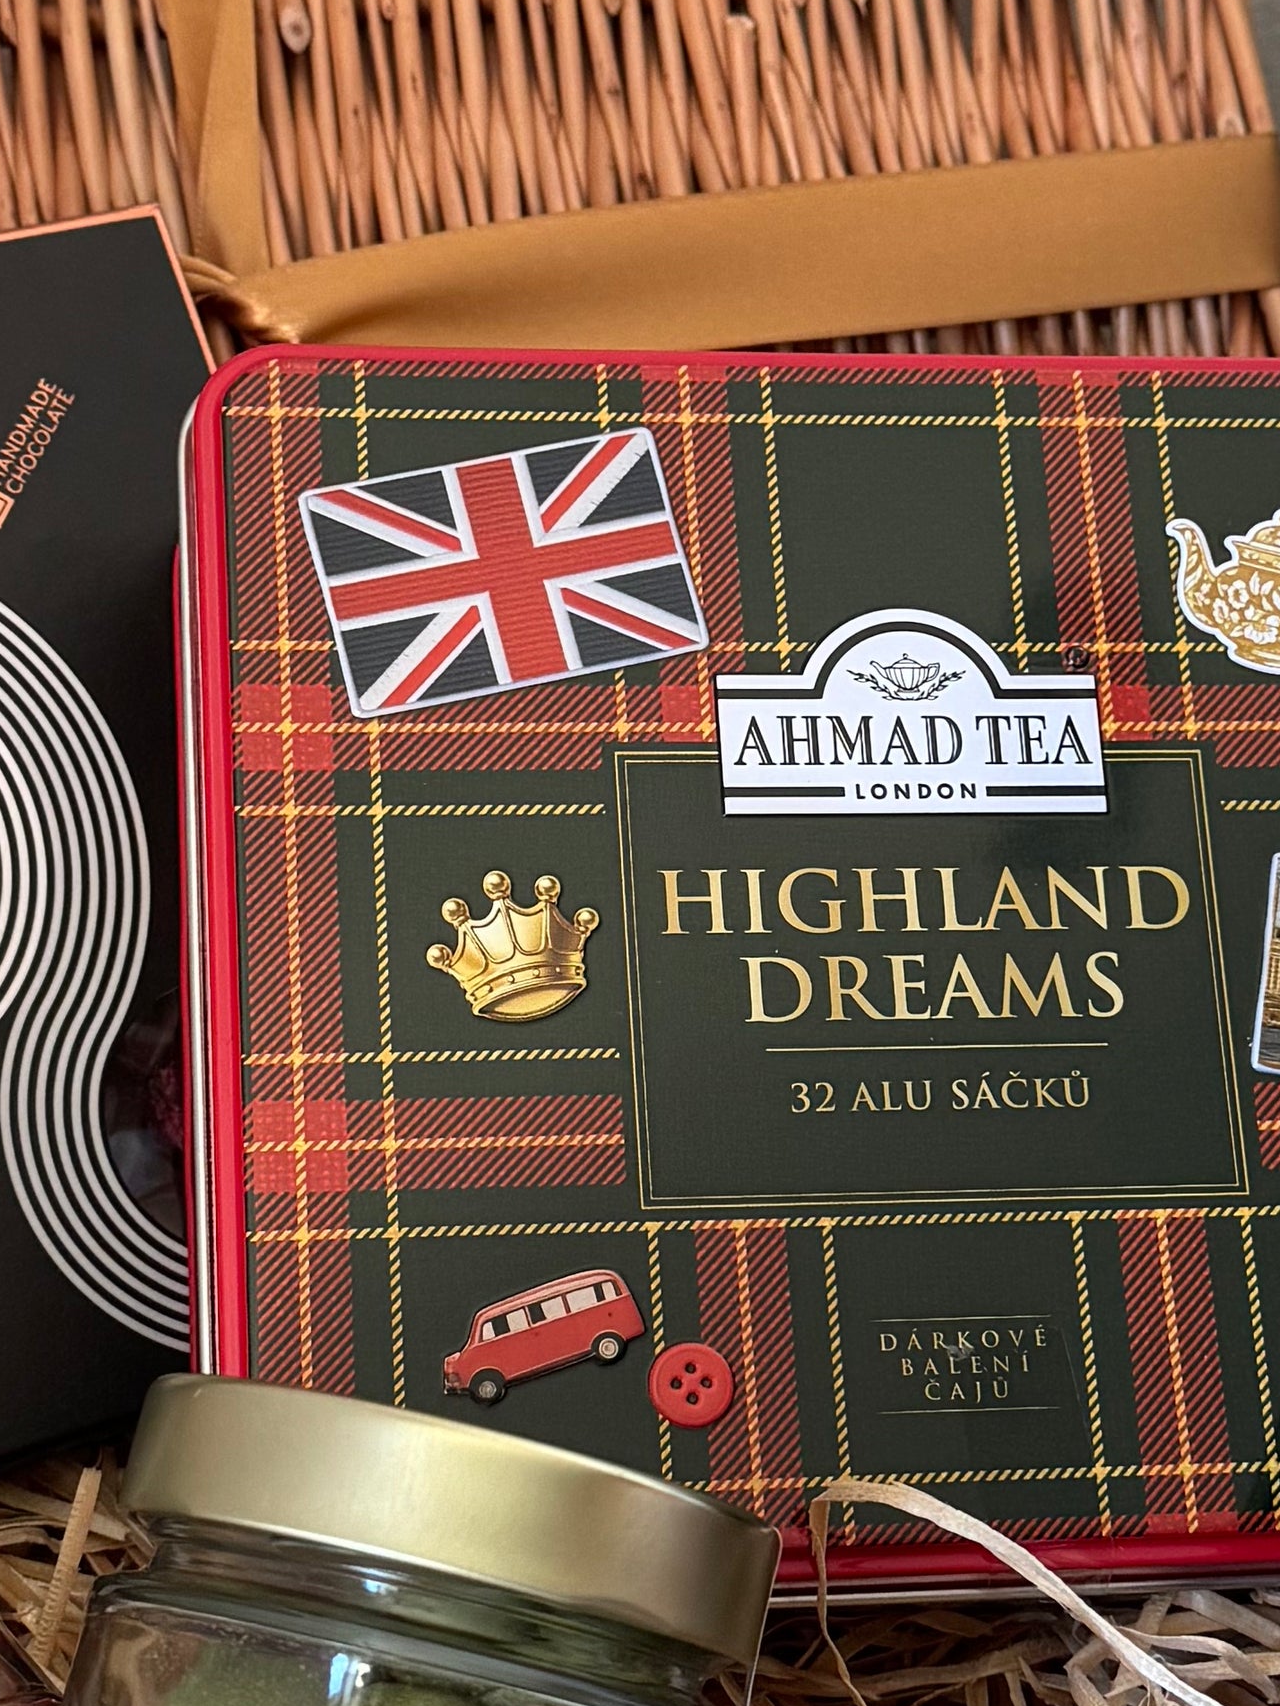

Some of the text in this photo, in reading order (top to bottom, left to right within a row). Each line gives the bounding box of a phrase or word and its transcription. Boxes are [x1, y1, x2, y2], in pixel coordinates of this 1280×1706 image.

[5, 388, 75, 494] CHOCOLATE
[733, 714, 1093, 766] AHMAD TEA
[855, 782, 978, 801] LONDON
[656, 865, 1191, 935] HIGHLAND
[739, 951, 1124, 1024] DREAMS
[790, 1070, 1091, 1114] 32 ALU SÁČKŮ
[880, 1323, 1047, 1352] DÁRKOVÉ
[901, 1350, 1030, 1377] BALENÍ
[924, 1376, 1010, 1403] ČAJŮ
